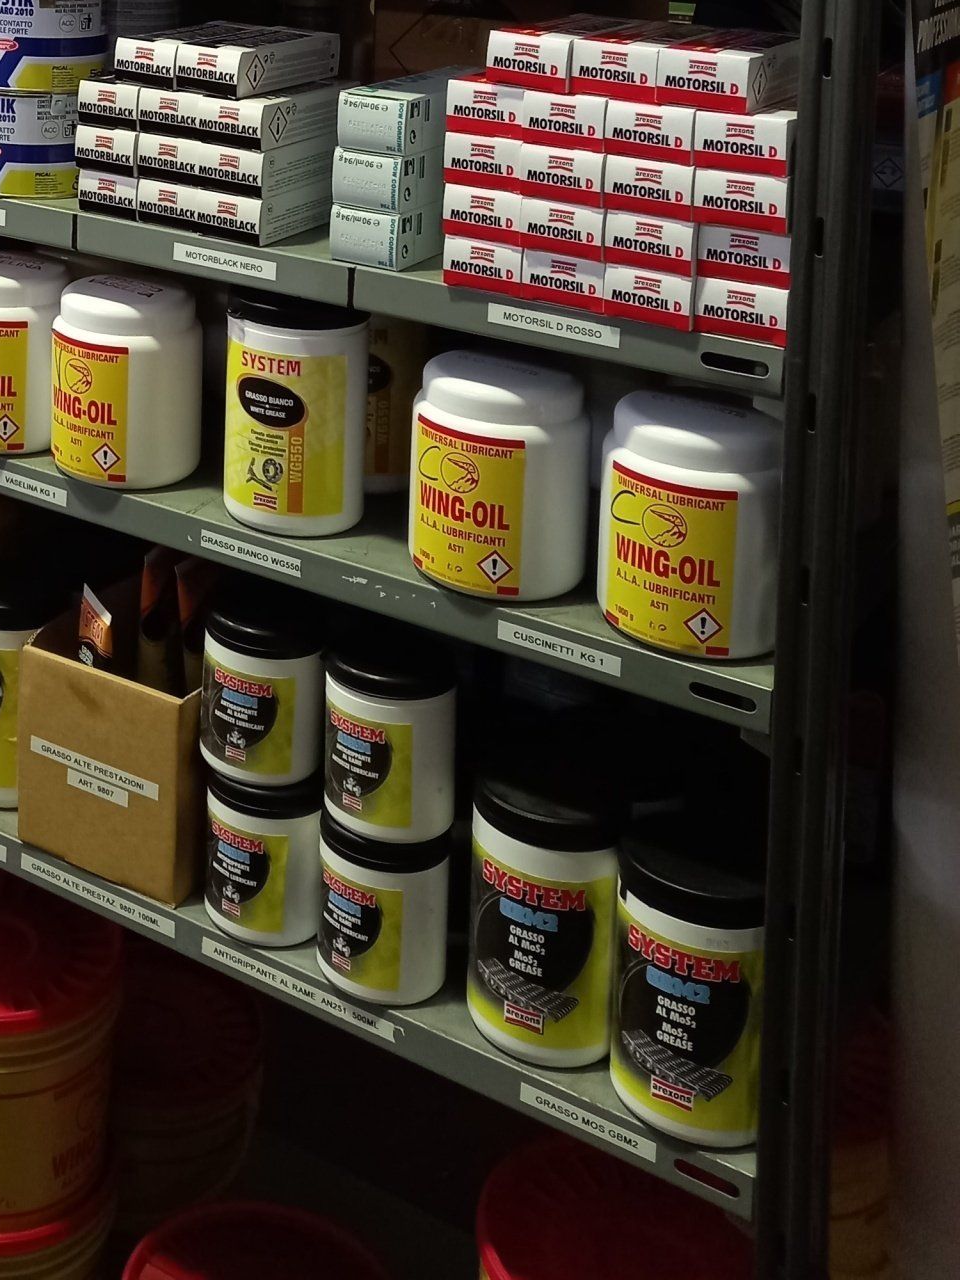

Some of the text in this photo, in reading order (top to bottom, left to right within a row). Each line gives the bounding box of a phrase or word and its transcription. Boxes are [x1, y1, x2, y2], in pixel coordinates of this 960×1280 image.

[116, 58, 172, 77] MOTORBLACK
[665, 75, 739, 95] MOTORSIL D
[185, 250, 262, 272] MOTORBLACK NERO
[503, 311, 602, 338] MOTORSIL D ROSSO
[4, 475, 38, 492] VASELINA
[39, 487, 50, 496] KG
[618, 476, 726, 512] UNIVERSAL LUBRICANT
[200, 535, 300, 571] GRASSO BIANCO WG550
[616, 532, 721, 588] WING-OIL
[616, 568, 716, 606] A.L.A. LUBRIFICANTI
[649, 599, 669, 612] ASTI
[513, 631, 573, 655] CUSCINETTI
[580, 651, 595, 662] KG
[41, 744, 144, 790] GRASSO ALTE PRESTAZIONI
[78, 778, 114, 796] ART. 9807
[31, 863, 60, 881] GRASSO
[62, 877, 80, 890] ALTE
[119, 903, 135, 915] 9807
[137, 911, 160, 927] 100ML
[213, 947, 380, 1029] ANTIGRIPPANTE AL RAME AN251 500ML
[535, 1096, 638, 1148] GRASSO MOS GBM2
